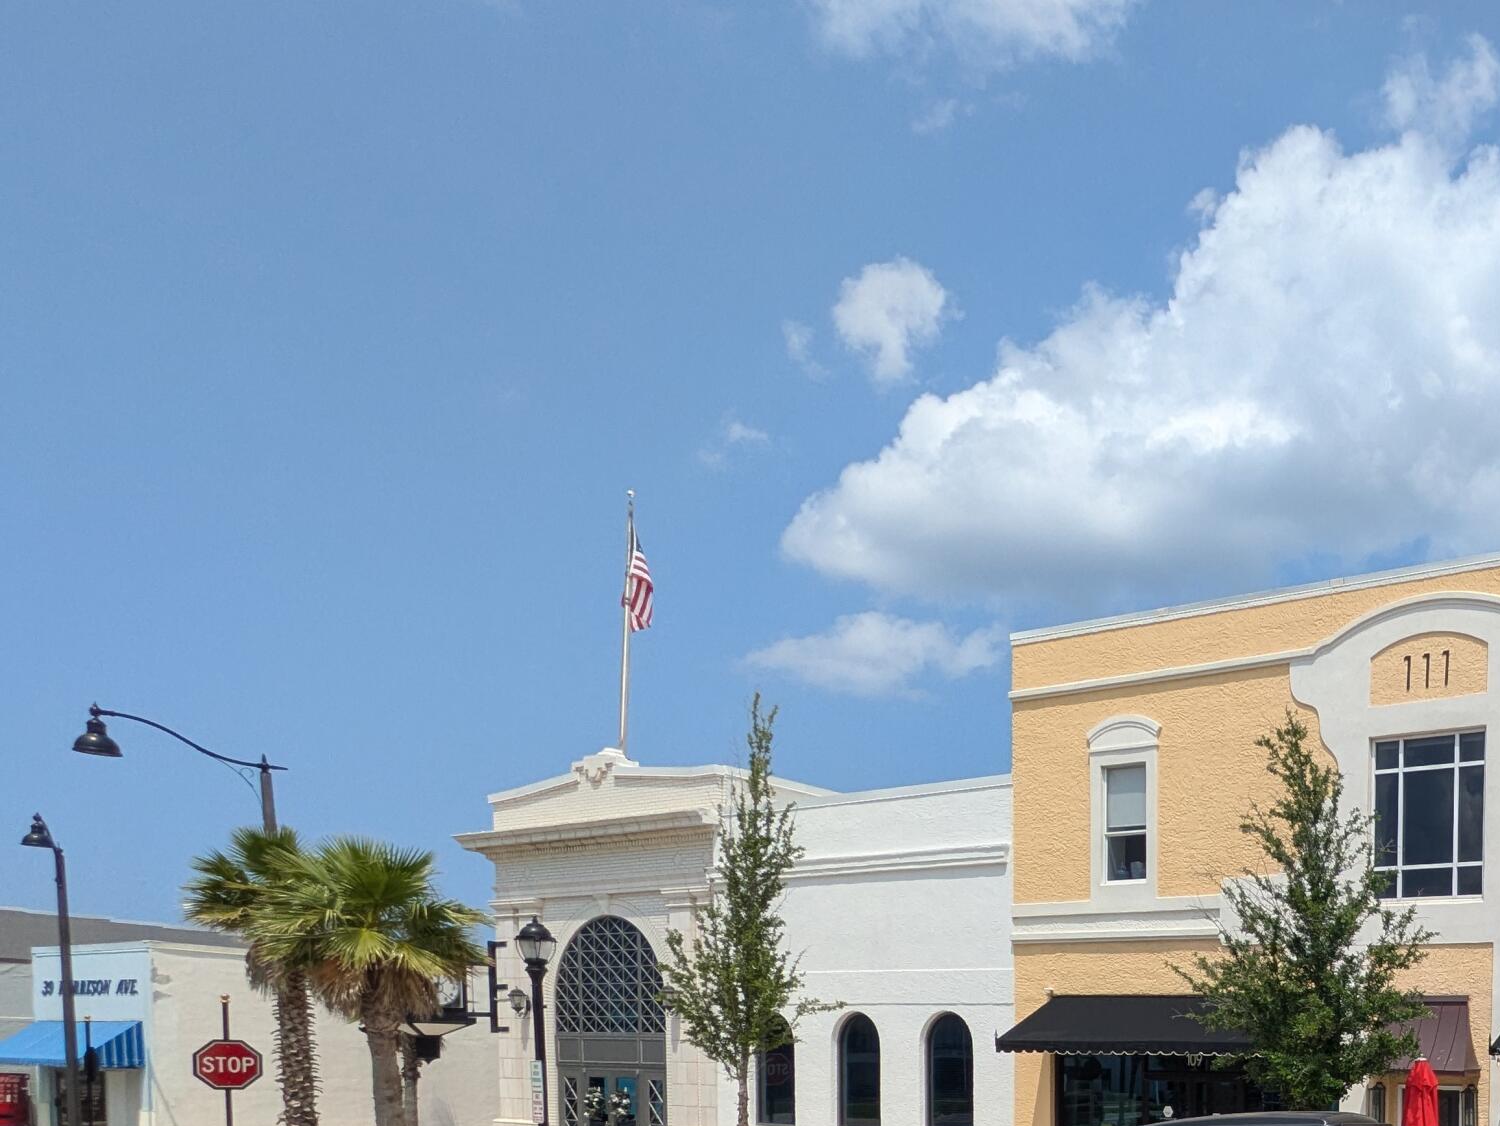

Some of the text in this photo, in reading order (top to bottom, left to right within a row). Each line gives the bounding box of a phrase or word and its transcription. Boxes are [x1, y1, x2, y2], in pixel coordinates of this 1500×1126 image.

[1403, 650, 1450, 692] 111
[42, 980, 54, 996] 39
[201, 1056, 255, 1073] STOP
